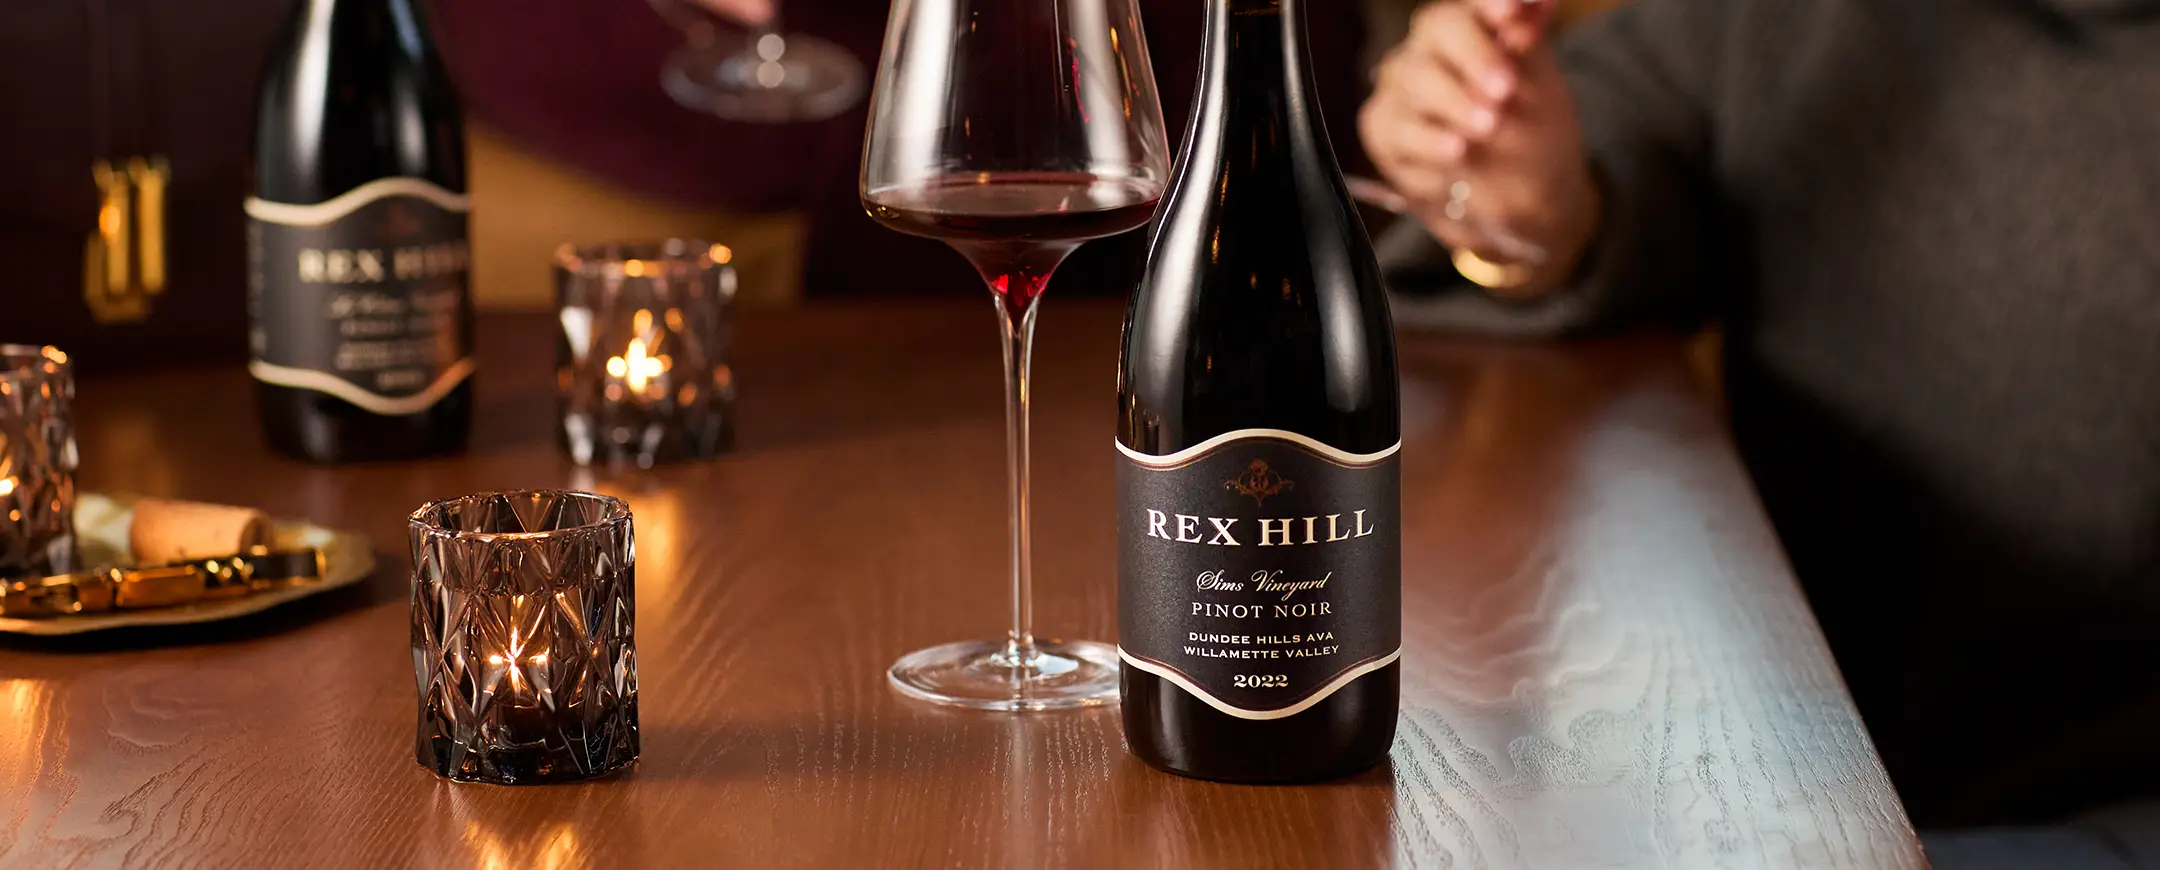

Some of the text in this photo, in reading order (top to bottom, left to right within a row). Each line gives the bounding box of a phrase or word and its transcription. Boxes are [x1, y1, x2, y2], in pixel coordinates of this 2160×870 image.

[1147, 508, 1375, 546] REX HILL
[1196, 569, 1333, 601] Sims Vineyard
[1191, 601, 1332, 619] PINOT NOIR
[1189, 632, 1334, 644] DUNDEE HILLS AVA
[1183, 645, 1340, 659] WILLAMETTE VALLEY
[1233, 674, 1289, 688] 2022
